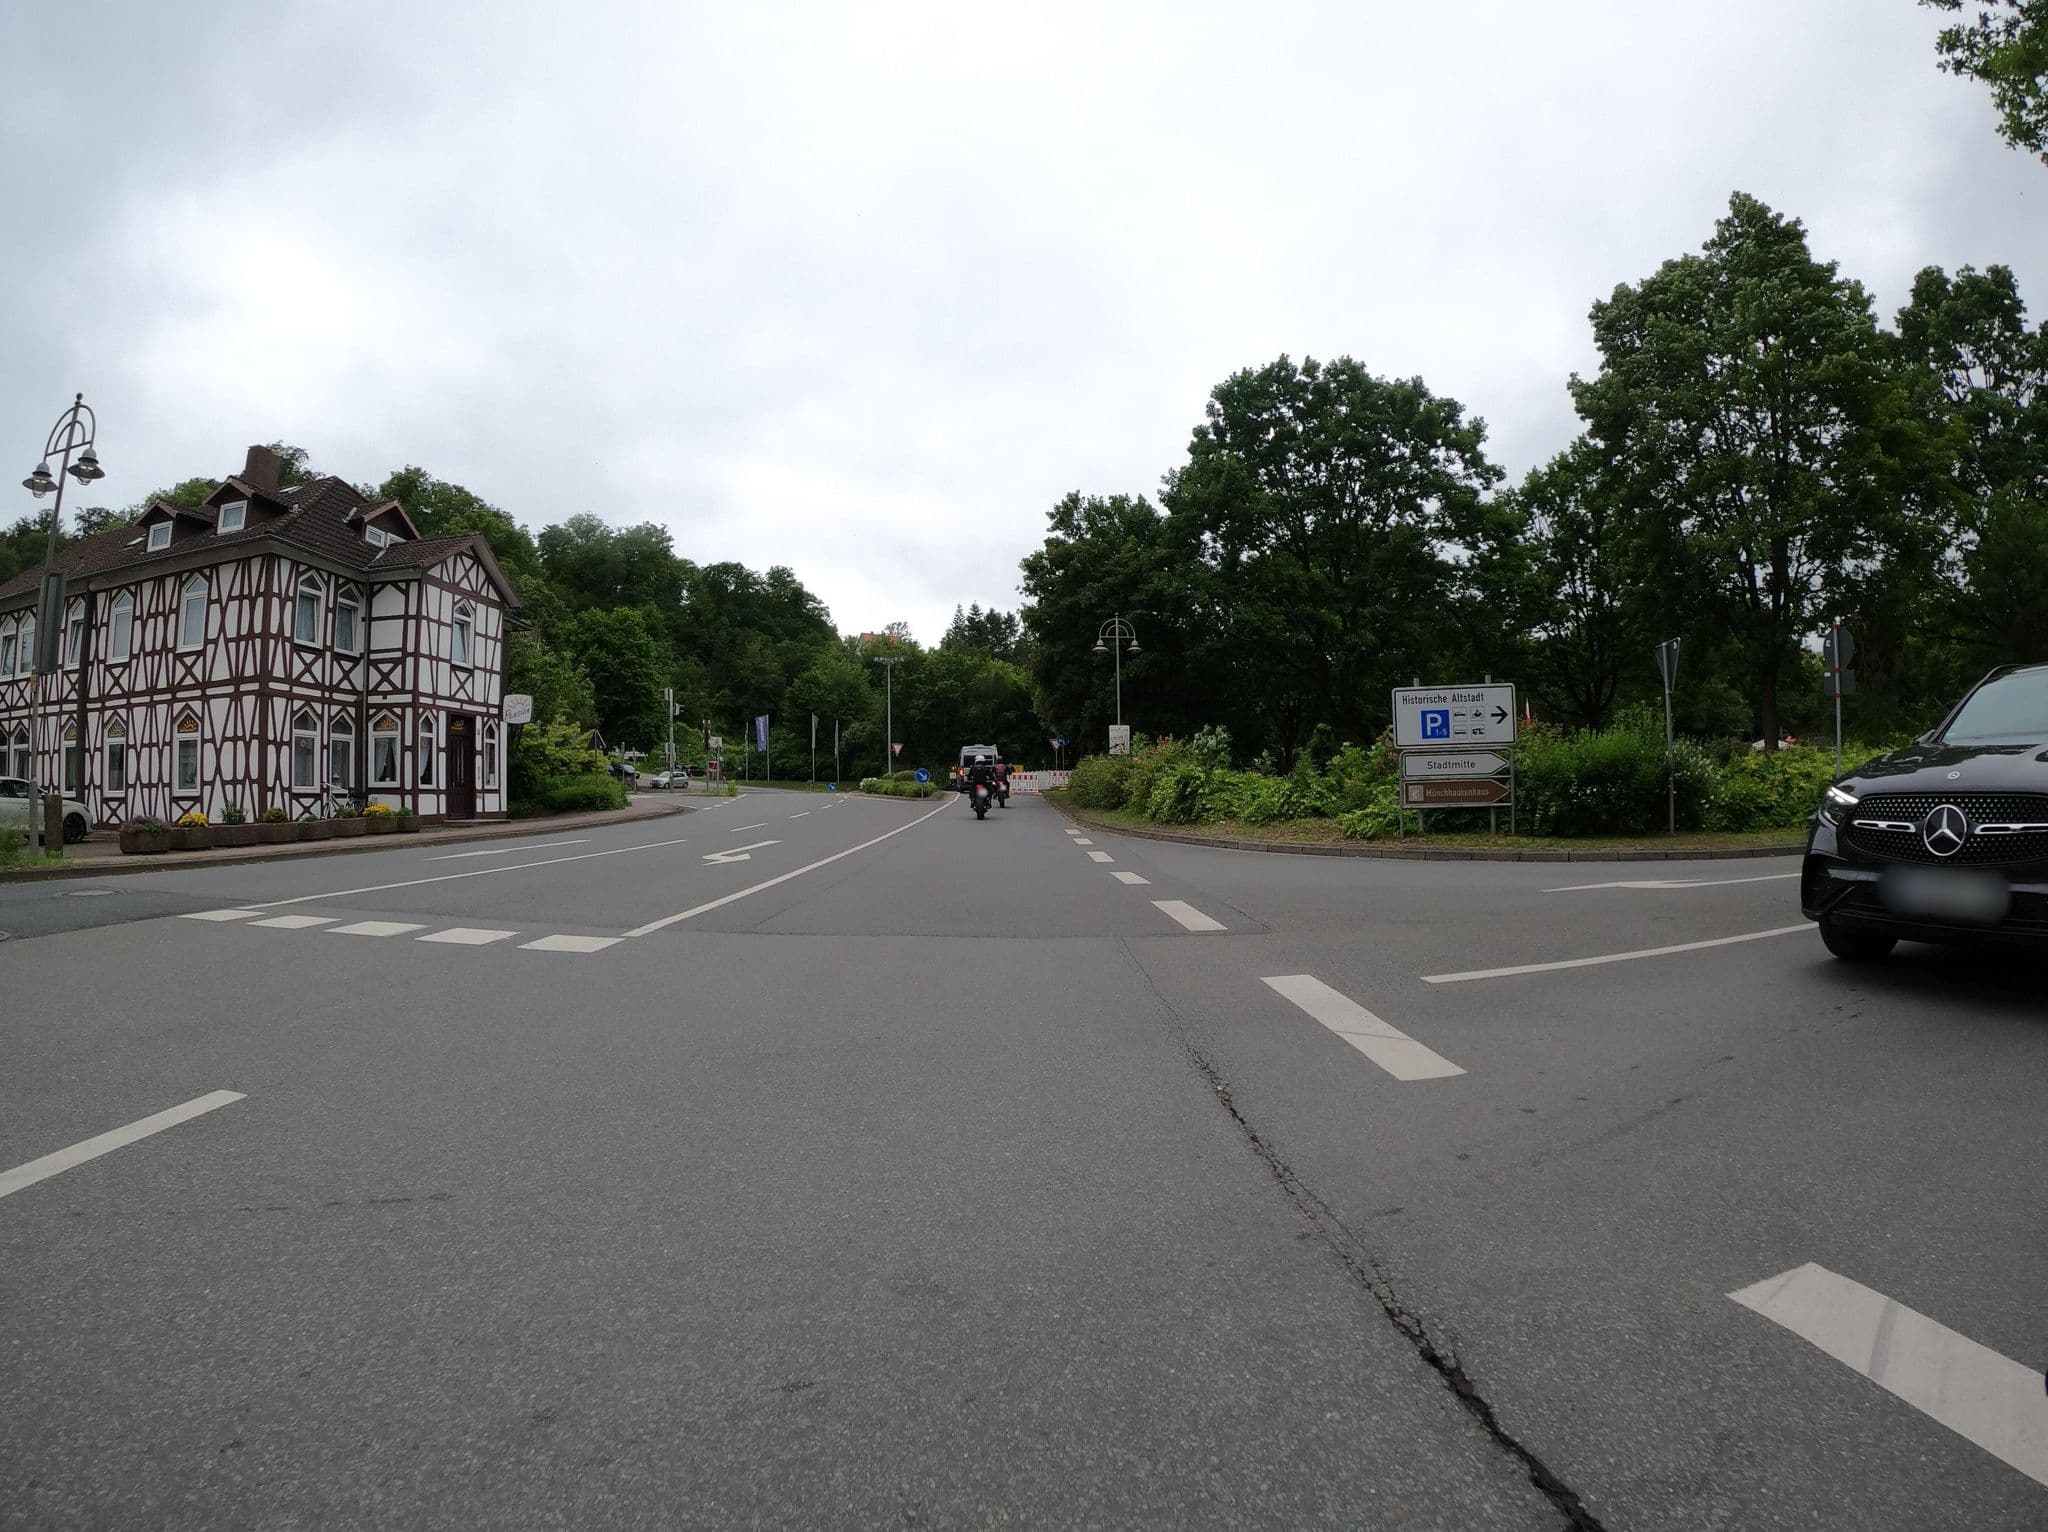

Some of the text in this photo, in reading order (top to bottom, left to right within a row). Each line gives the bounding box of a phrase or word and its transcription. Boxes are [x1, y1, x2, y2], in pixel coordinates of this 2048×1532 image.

[1402, 692, 1484, 705] Historische Altstadt
[1426, 713, 1442, 736] P
[1427, 760, 1476, 770] Stadtmitte
[1426, 787, 1489, 797] Münchhausenhaus
